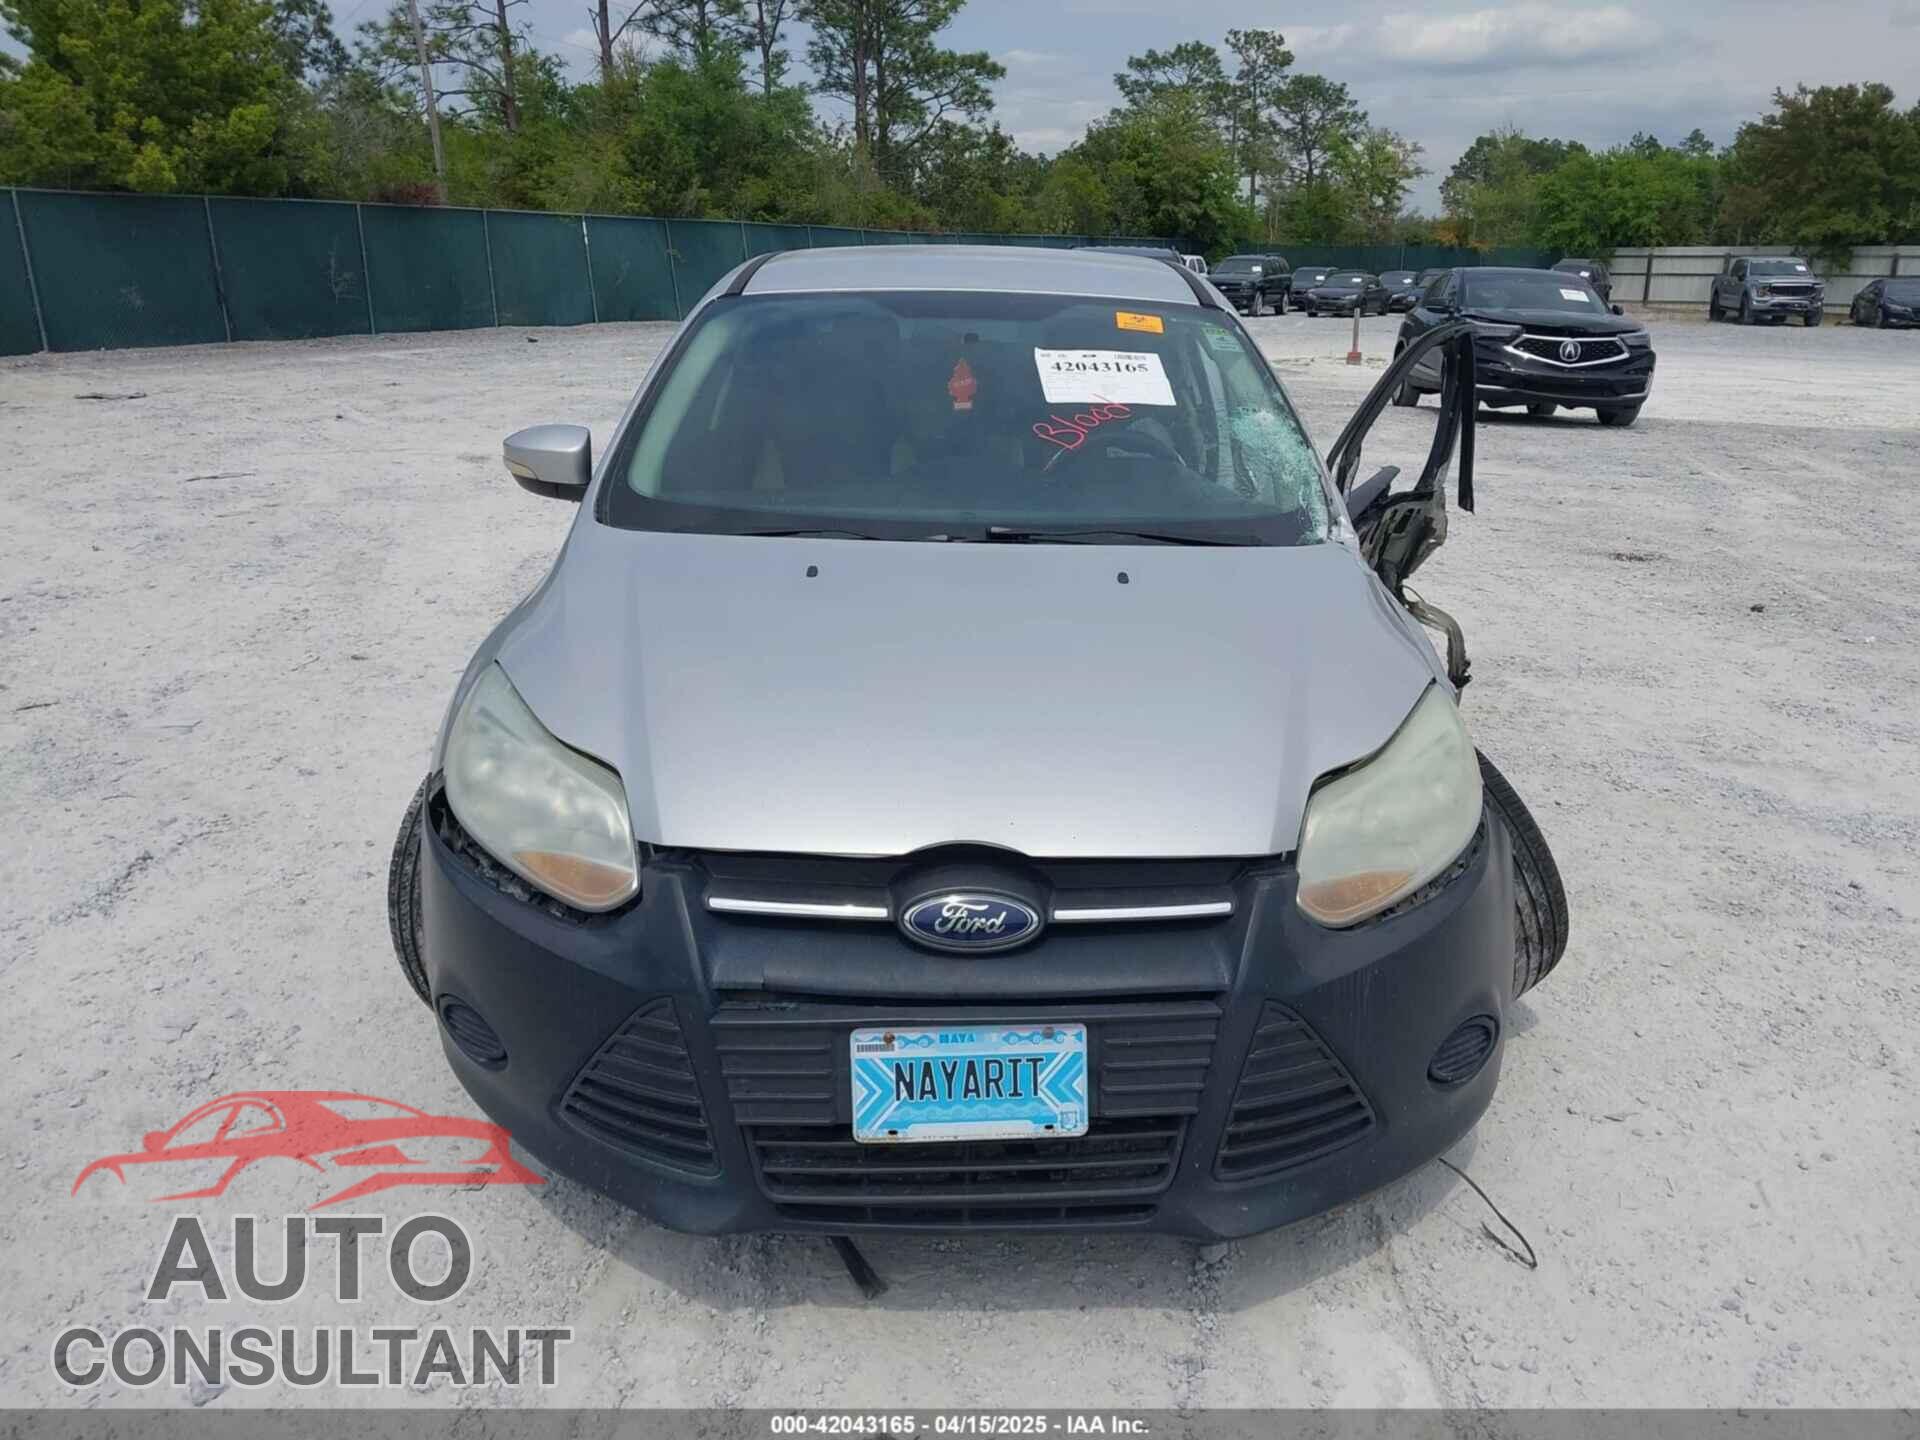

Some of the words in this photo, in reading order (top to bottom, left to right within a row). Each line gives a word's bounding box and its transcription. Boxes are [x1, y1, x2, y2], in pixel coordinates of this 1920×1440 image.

[1051, 361, 1149, 373] 42043165
[1033, 393, 1131, 449] Blood
[934, 901, 1007, 933] Ford
[894, 1057, 1045, 1102] NAYARIT
